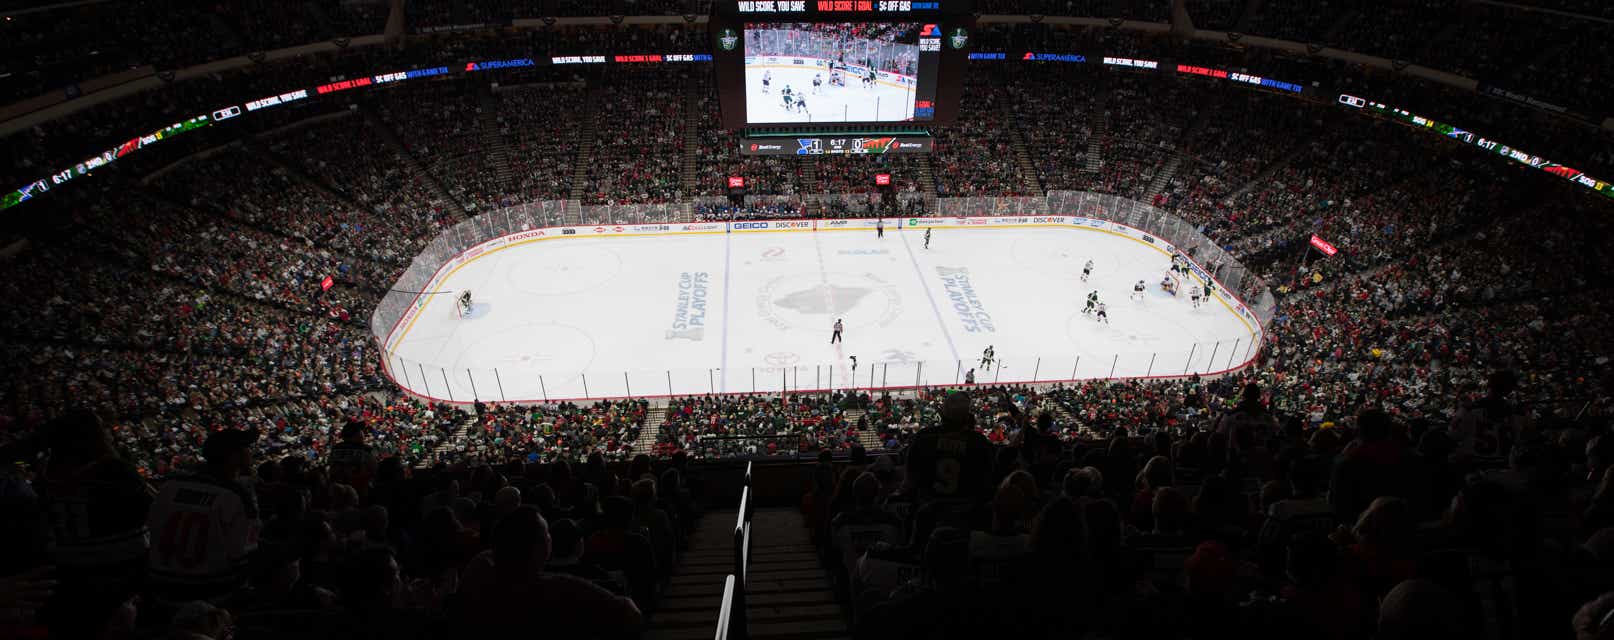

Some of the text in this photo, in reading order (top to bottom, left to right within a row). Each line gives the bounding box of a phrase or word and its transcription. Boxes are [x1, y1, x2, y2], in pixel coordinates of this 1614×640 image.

[738, 1, 805, 12] WILD SCORE, YOU SAVE
[817, 1, 833, 11] WILD
[834, 1, 853, 11] SCORE
[858, 1, 872, 11] GOAL
[888, 1, 899, 11] OFF
[900, 1, 911, 11] GAS
[1036, 52, 1086, 62] SUPERAMERICA
[480, 58, 535, 70] SUPERAMERICA
[384, 73, 394, 82] OFF
[394, 72, 407, 80] GAS
[1177, 64, 1192, 73] WILD
[1192, 66, 1209, 75] SCORE
[1214, 70, 1228, 78] GOAL
[1238, 74, 1249, 82] OFF
[1249, 76, 1261, 84] GAS
[316, 84, 333, 94] WILD
[334, 80, 352, 91] SCORE
[356, 77, 372, 86] GOAL
[245, 100, 261, 111] WILD
[280, 93, 293, 102] YOU
[292, 90, 307, 100] SAVE
[1478, 138, 1496, 150] 6:17
[1510, 150, 1528, 162] 2ND
[52, 170, 72, 184] 6:17
[1578, 175, 1596, 188] SOG
[508, 230, 545, 242] HONDA
[672, 272, 692, 330] STANLEY CUP
[689, 272, 709, 326] PLAYOFFS
